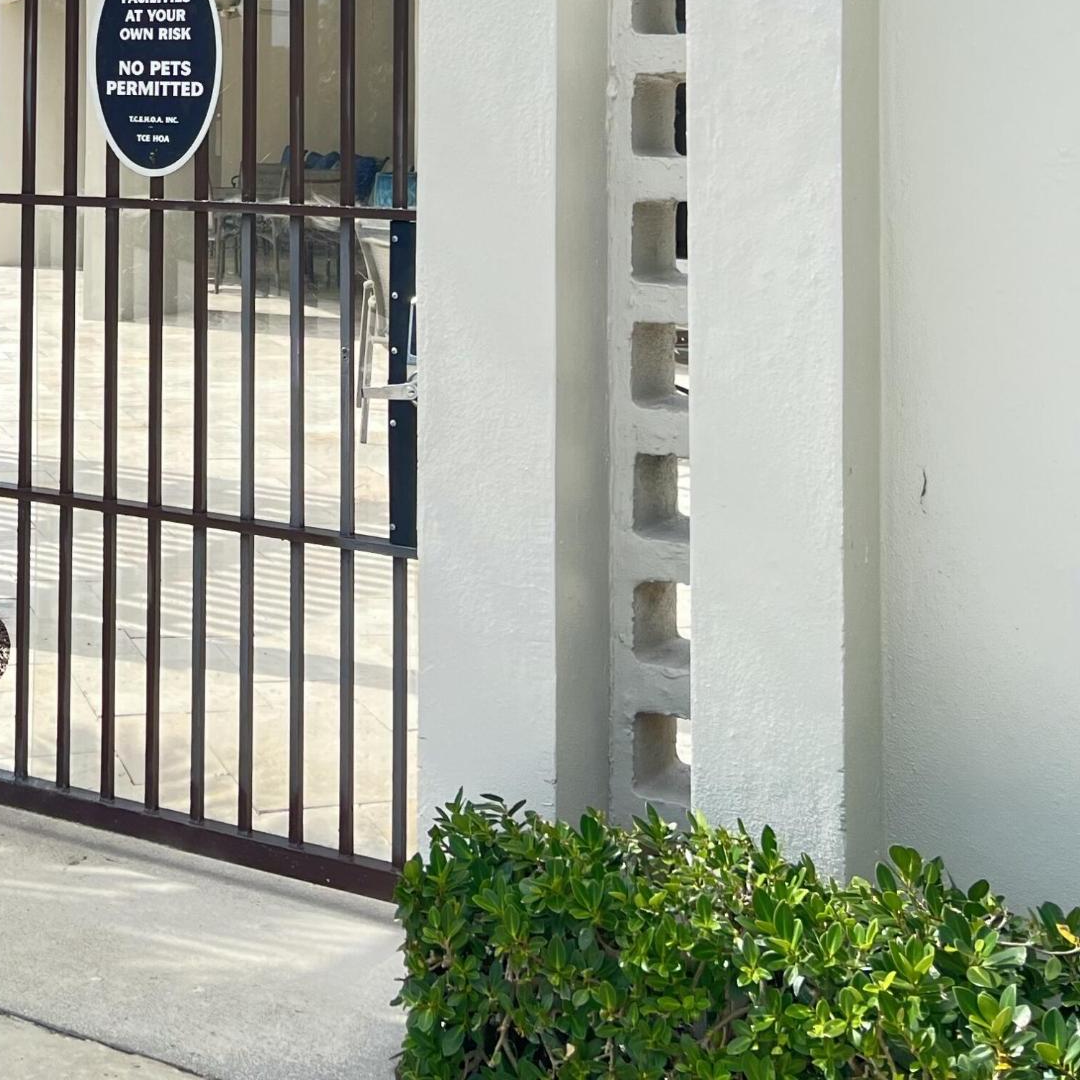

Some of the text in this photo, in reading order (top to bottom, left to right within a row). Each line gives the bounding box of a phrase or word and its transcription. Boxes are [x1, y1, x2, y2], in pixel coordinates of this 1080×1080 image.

[125, 9, 186, 22] AT YOUR
[119, 27, 191, 41] OWN RISK
[119, 60, 191, 76] NO PETS
[106, 81, 204, 97] PERMITTED
[136, 134, 170, 143] TCE HOA
